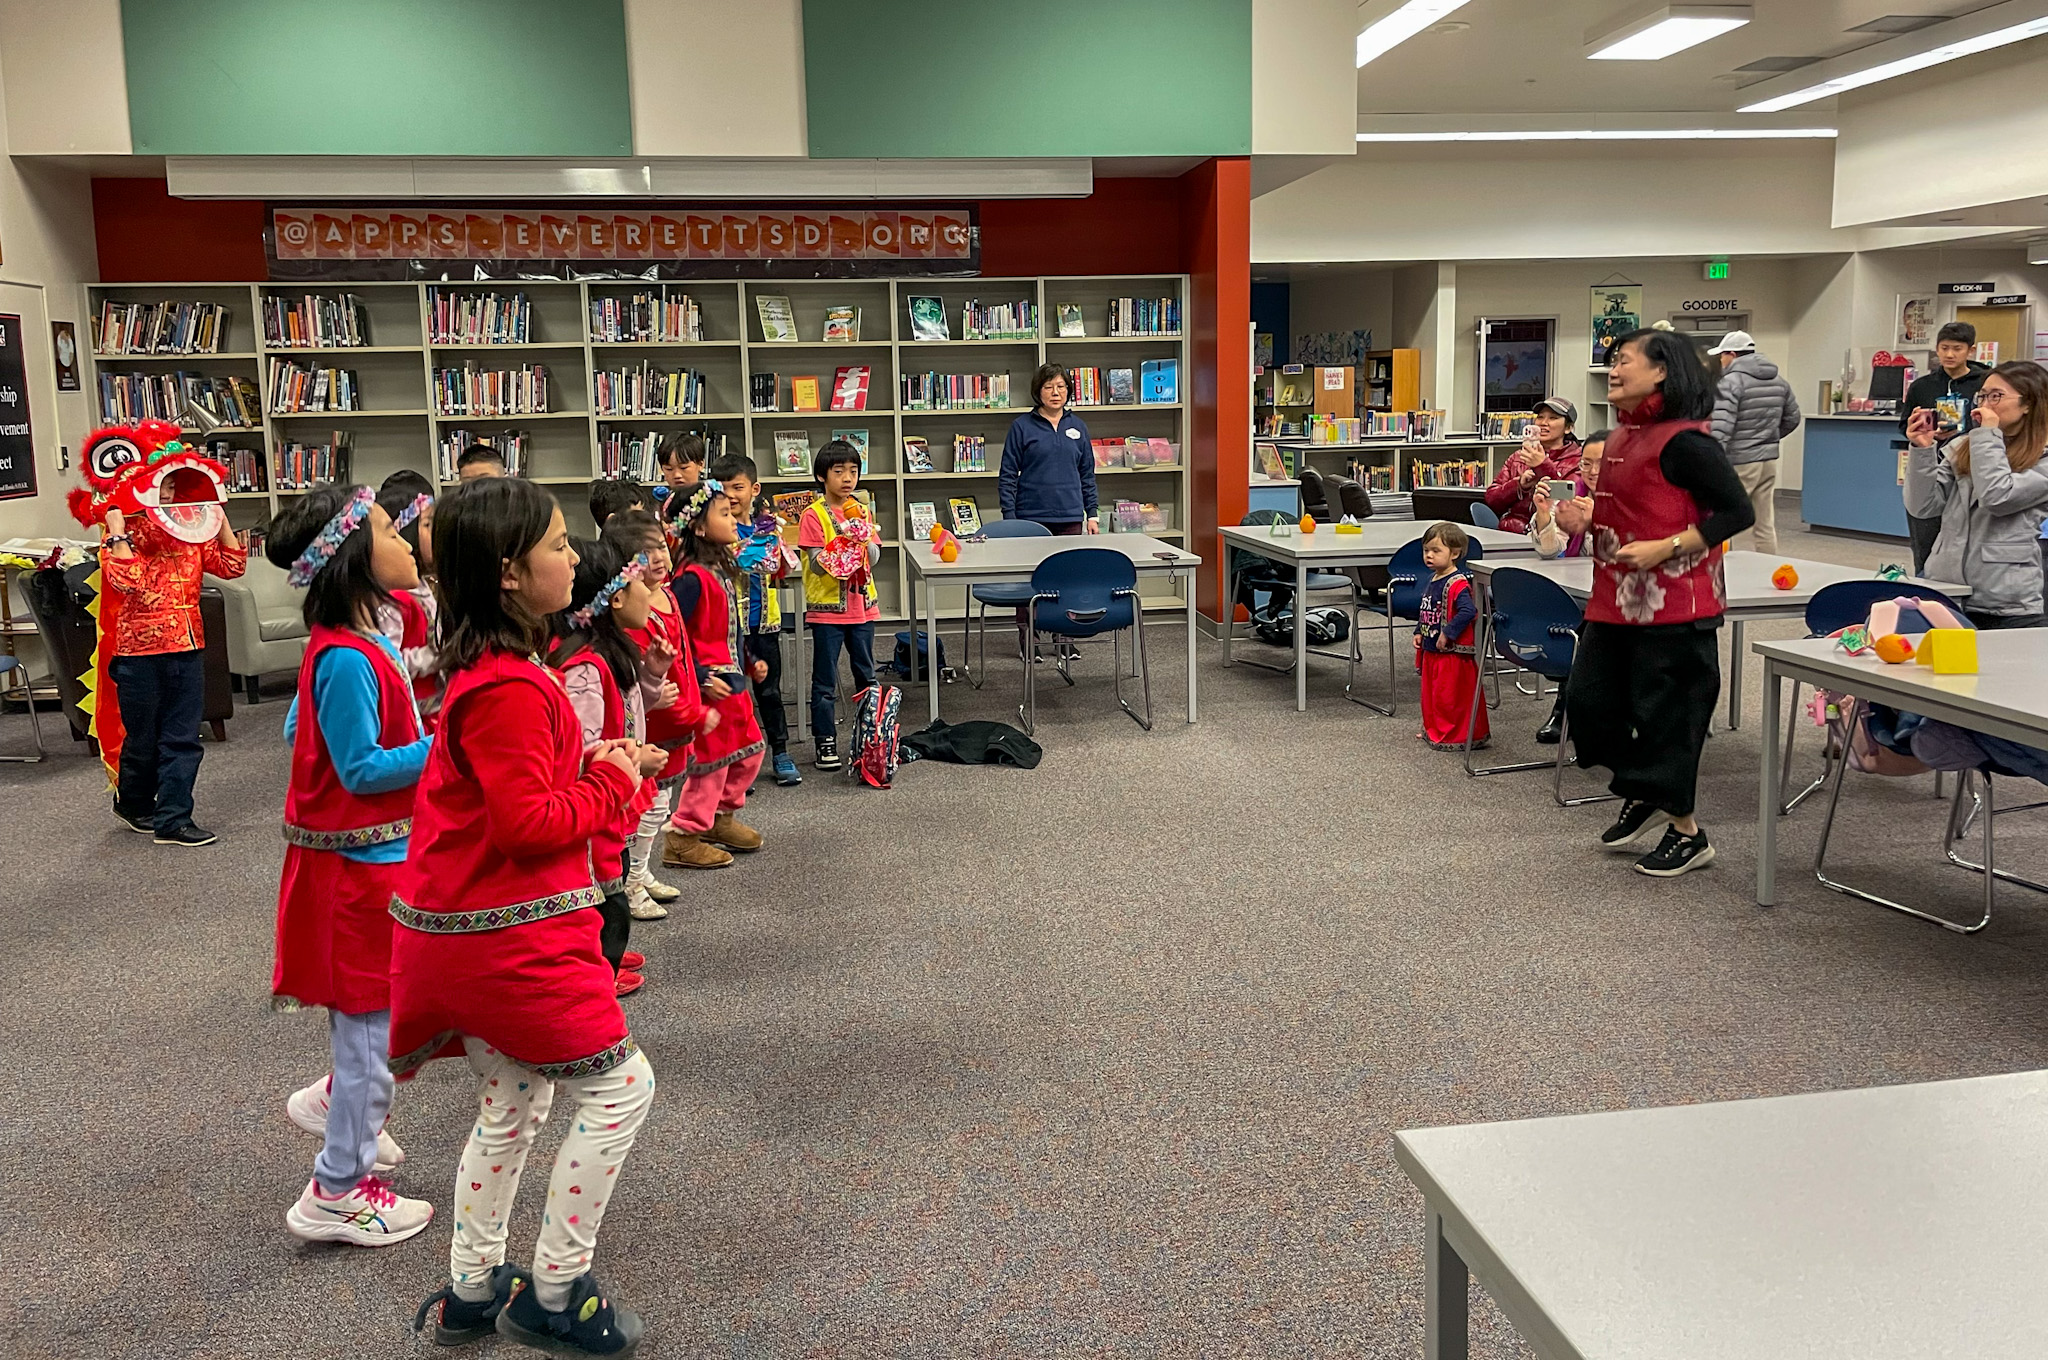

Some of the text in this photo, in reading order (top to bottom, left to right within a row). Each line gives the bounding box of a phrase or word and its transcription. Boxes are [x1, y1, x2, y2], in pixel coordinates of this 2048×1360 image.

[283, 220, 968, 246] @APPS.EVERETTSD.ORG
[1709, 264, 1728, 279] EXIT
[1952, 284, 1983, 292] CHECK-IN
[1682, 299, 1738, 311] GOODBYE
